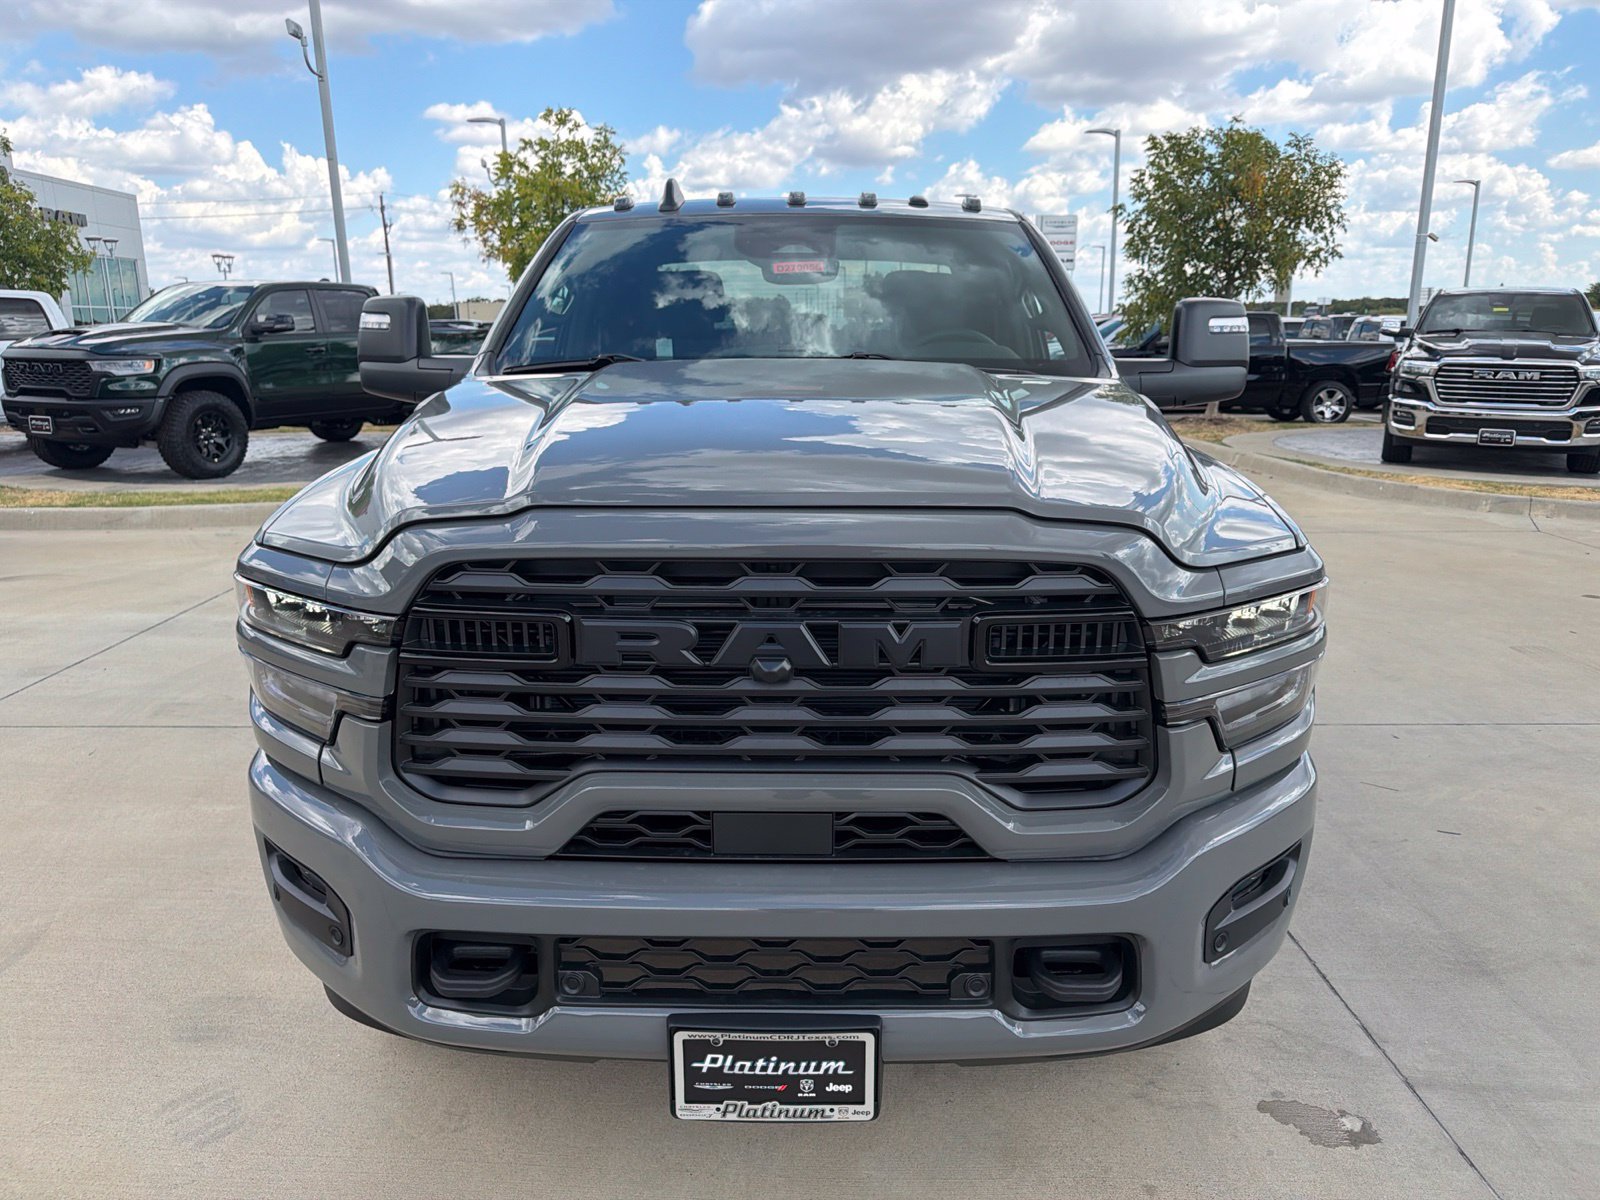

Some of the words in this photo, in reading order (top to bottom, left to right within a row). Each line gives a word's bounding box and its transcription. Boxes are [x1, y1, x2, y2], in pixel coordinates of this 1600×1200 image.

[16, 362, 63, 372] RAM
[1473, 371, 1541, 380] RAM
[577, 618, 965, 667] RAM
[691, 1054, 854, 1075] Platinum
[825, 1082, 853, 1093] Jeep
[720, 1102, 833, 1118] Platinum
